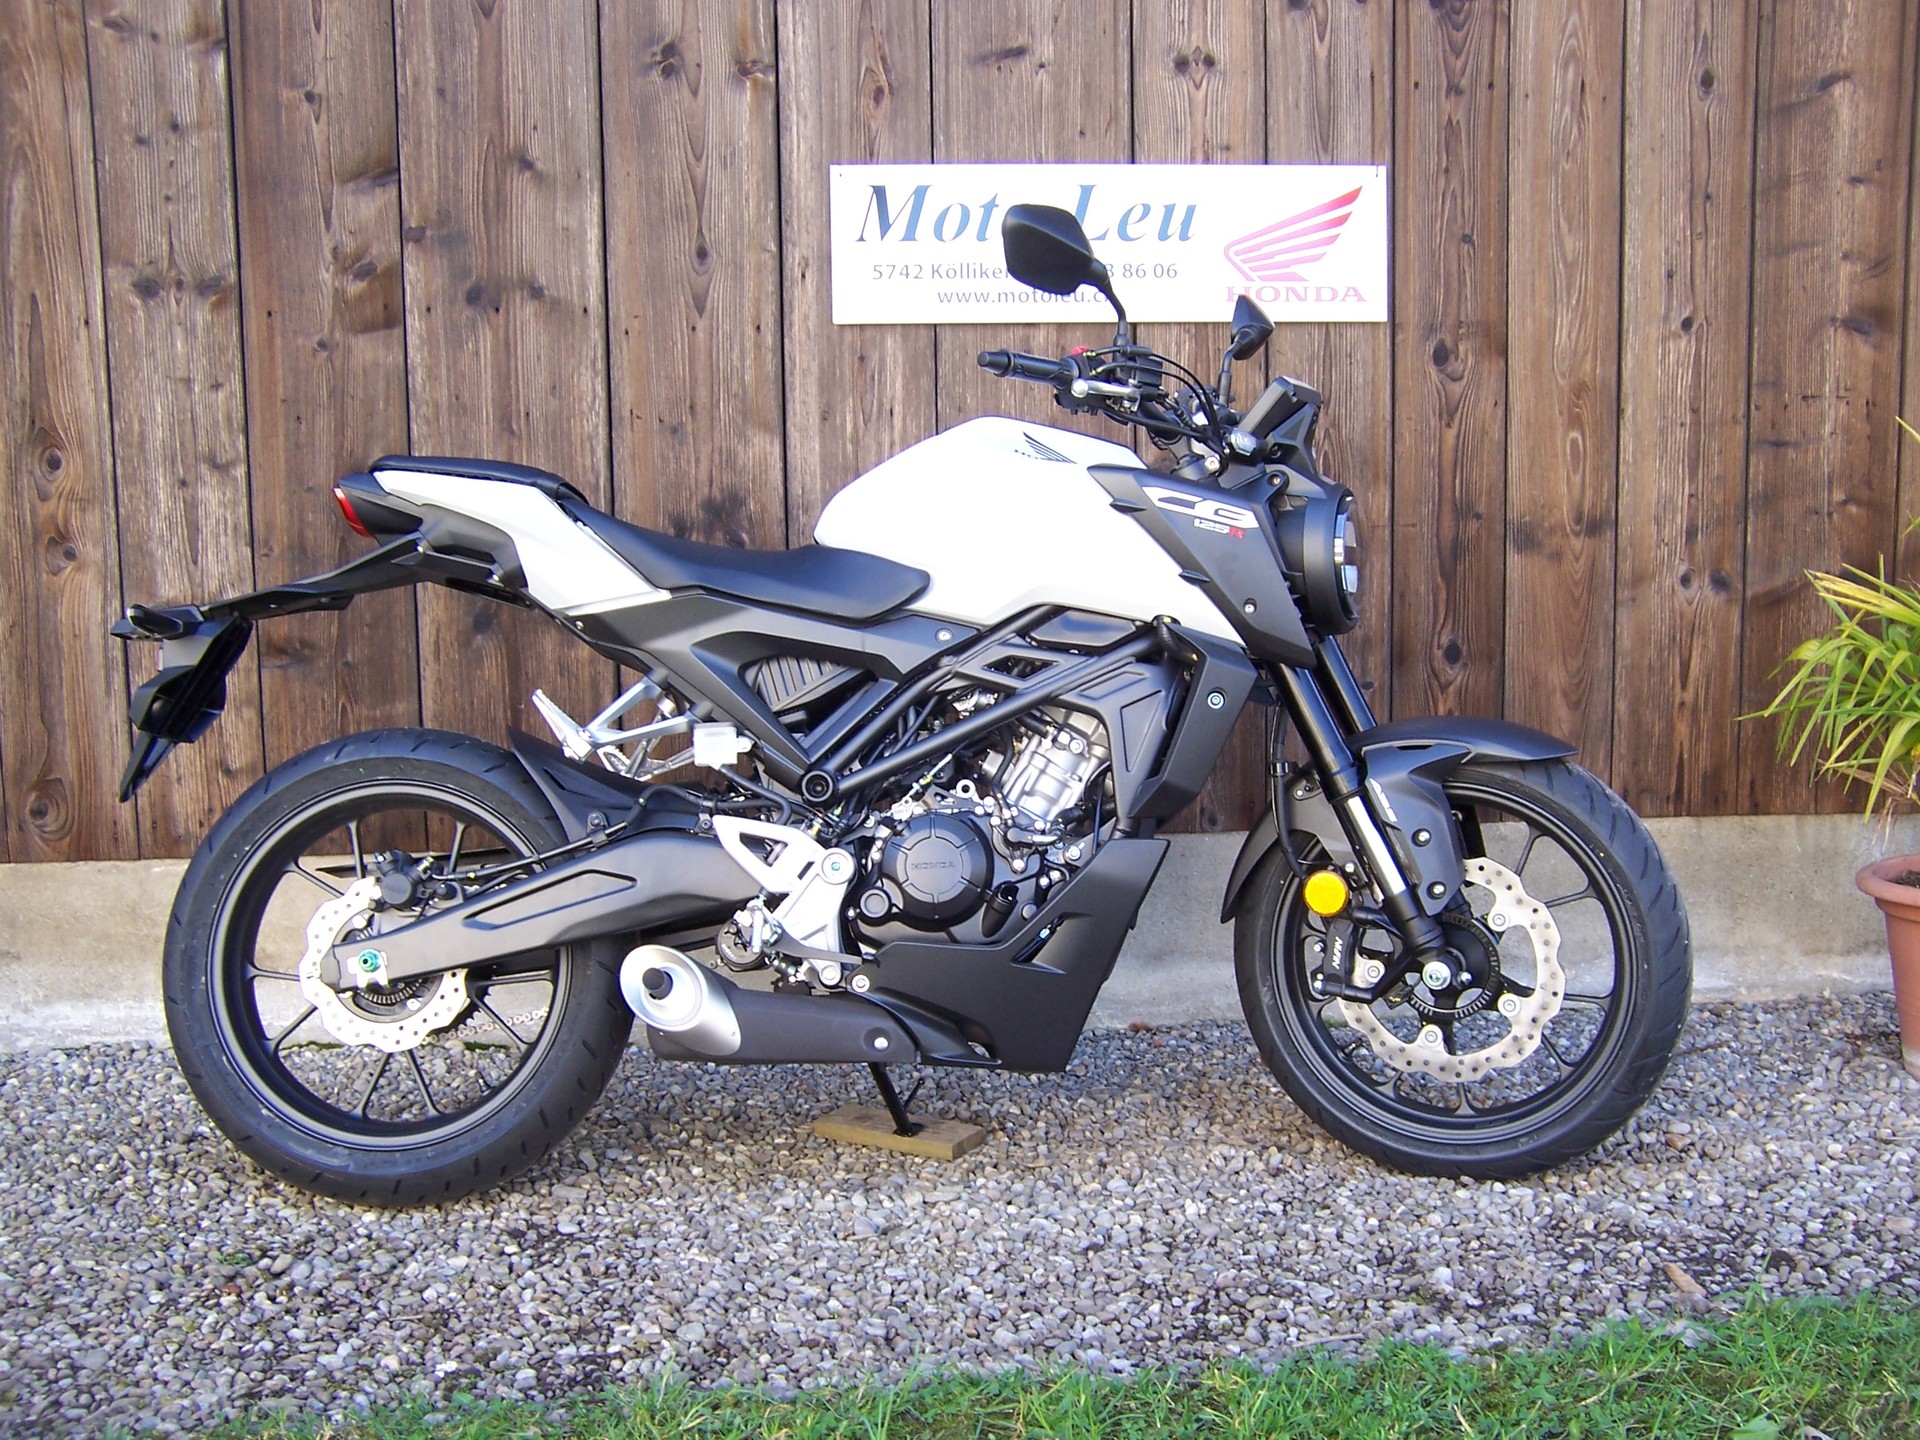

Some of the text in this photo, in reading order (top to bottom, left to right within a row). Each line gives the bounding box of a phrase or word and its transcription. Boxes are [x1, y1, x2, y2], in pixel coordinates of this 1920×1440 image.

[854, 184, 1197, 243] Mot Leu
[872, 264, 924, 280] 5742
[1122, 263, 1147, 279] 86
[1153, 263, 1178, 279] 06
[937, 287, 1108, 304] www.motoeu.c
[1225, 285, 1368, 303] HONDA
